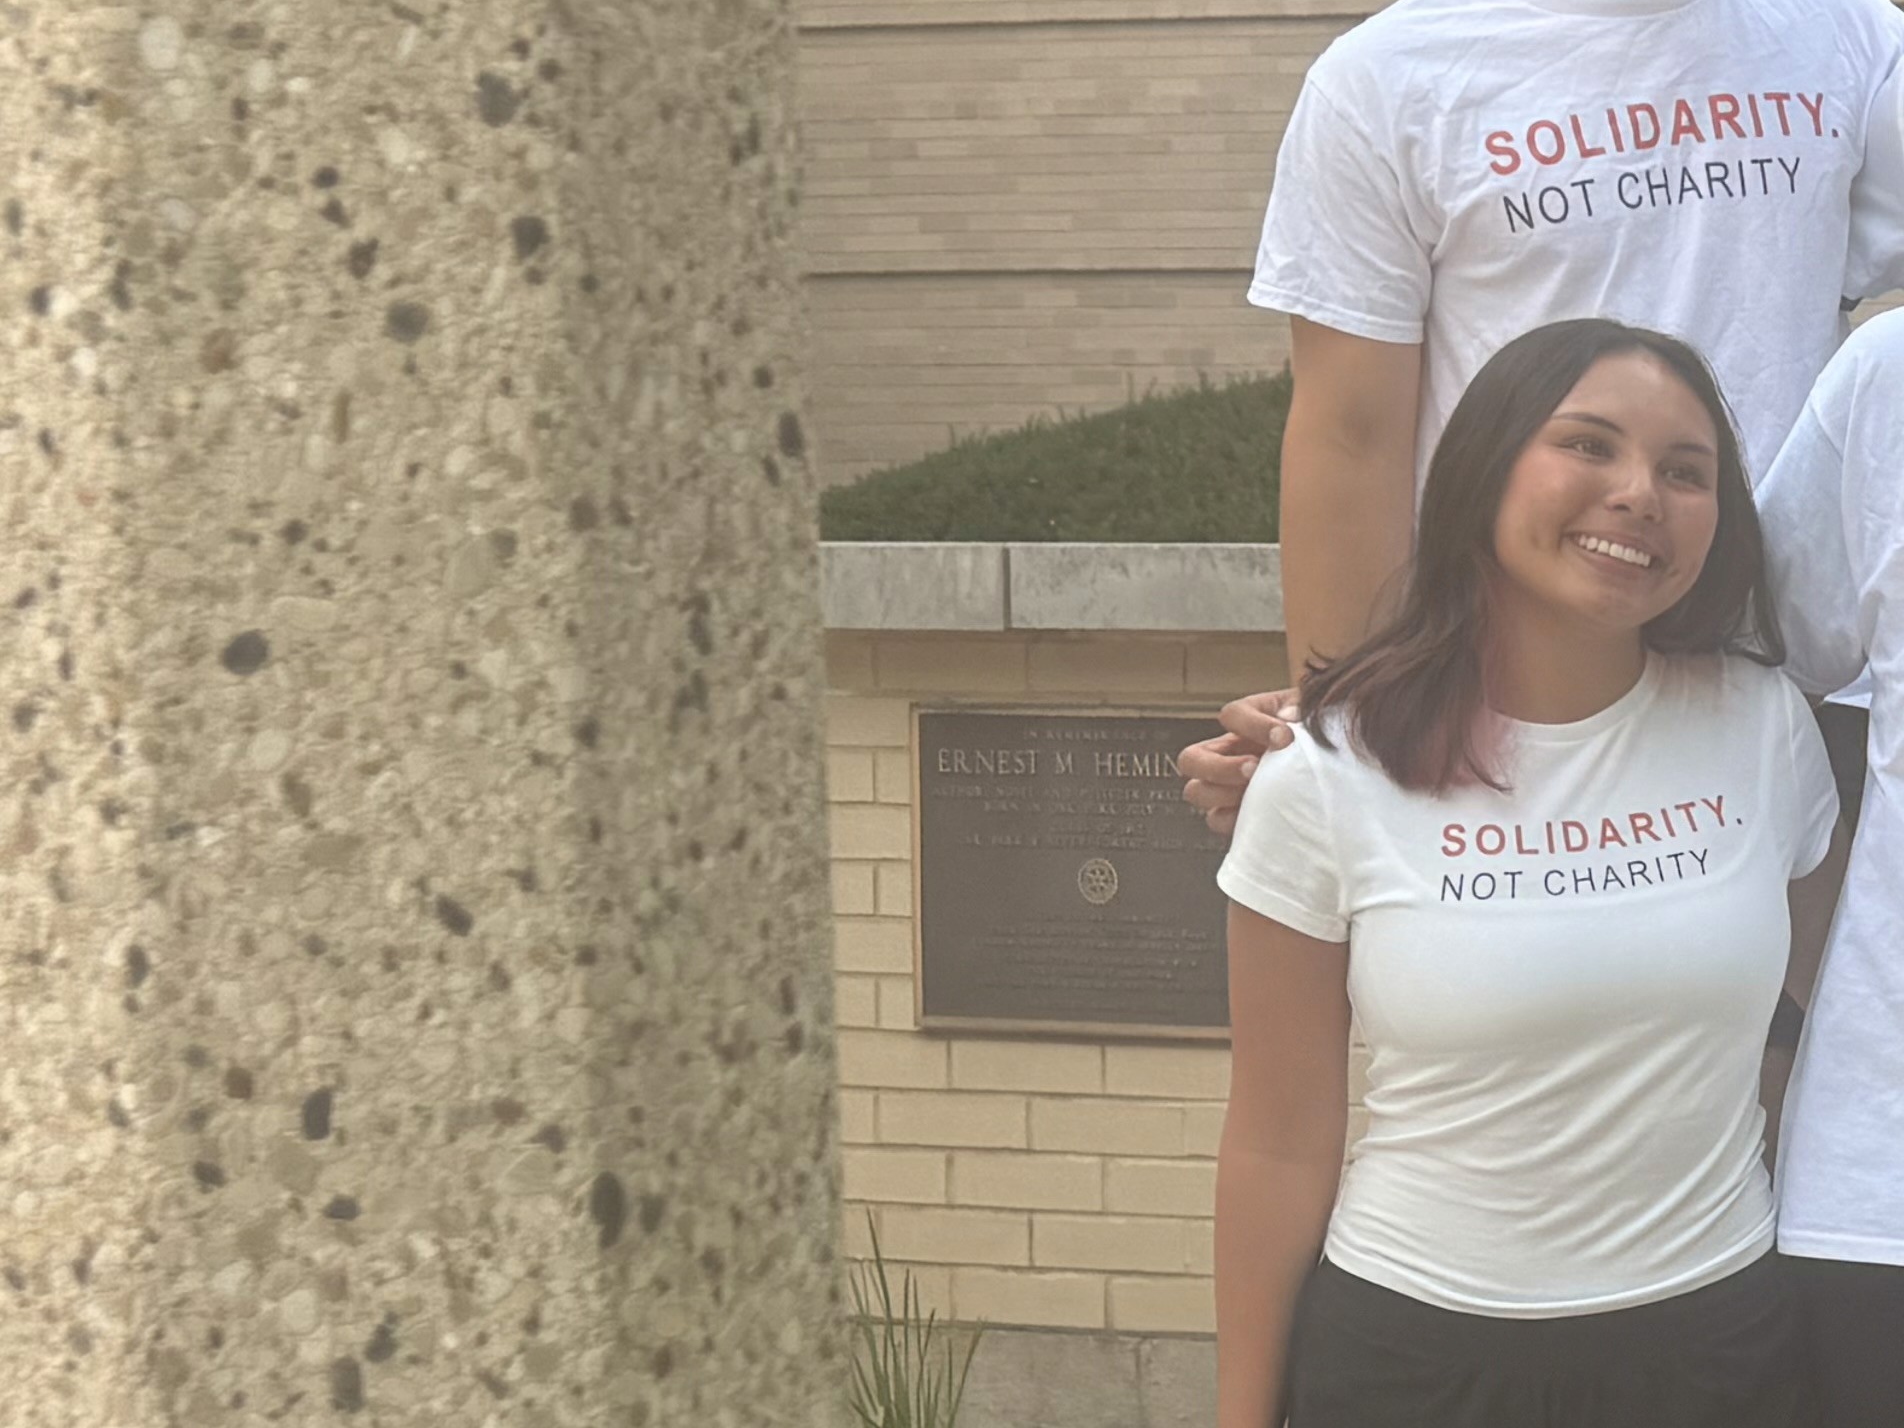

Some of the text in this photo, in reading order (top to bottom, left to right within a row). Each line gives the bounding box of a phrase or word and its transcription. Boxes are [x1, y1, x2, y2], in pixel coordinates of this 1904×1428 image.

[1485, 92, 1840, 176] SOLIDARITY.
[1503, 156, 1801, 234] NOT CHARITY
[938, 747, 1039, 775] ERNEST
[1095, 751, 1183, 778] HEMIN
[1441, 795, 1743, 858] SOLIDARITY.
[1441, 848, 1709, 902] NOT CHARITY
